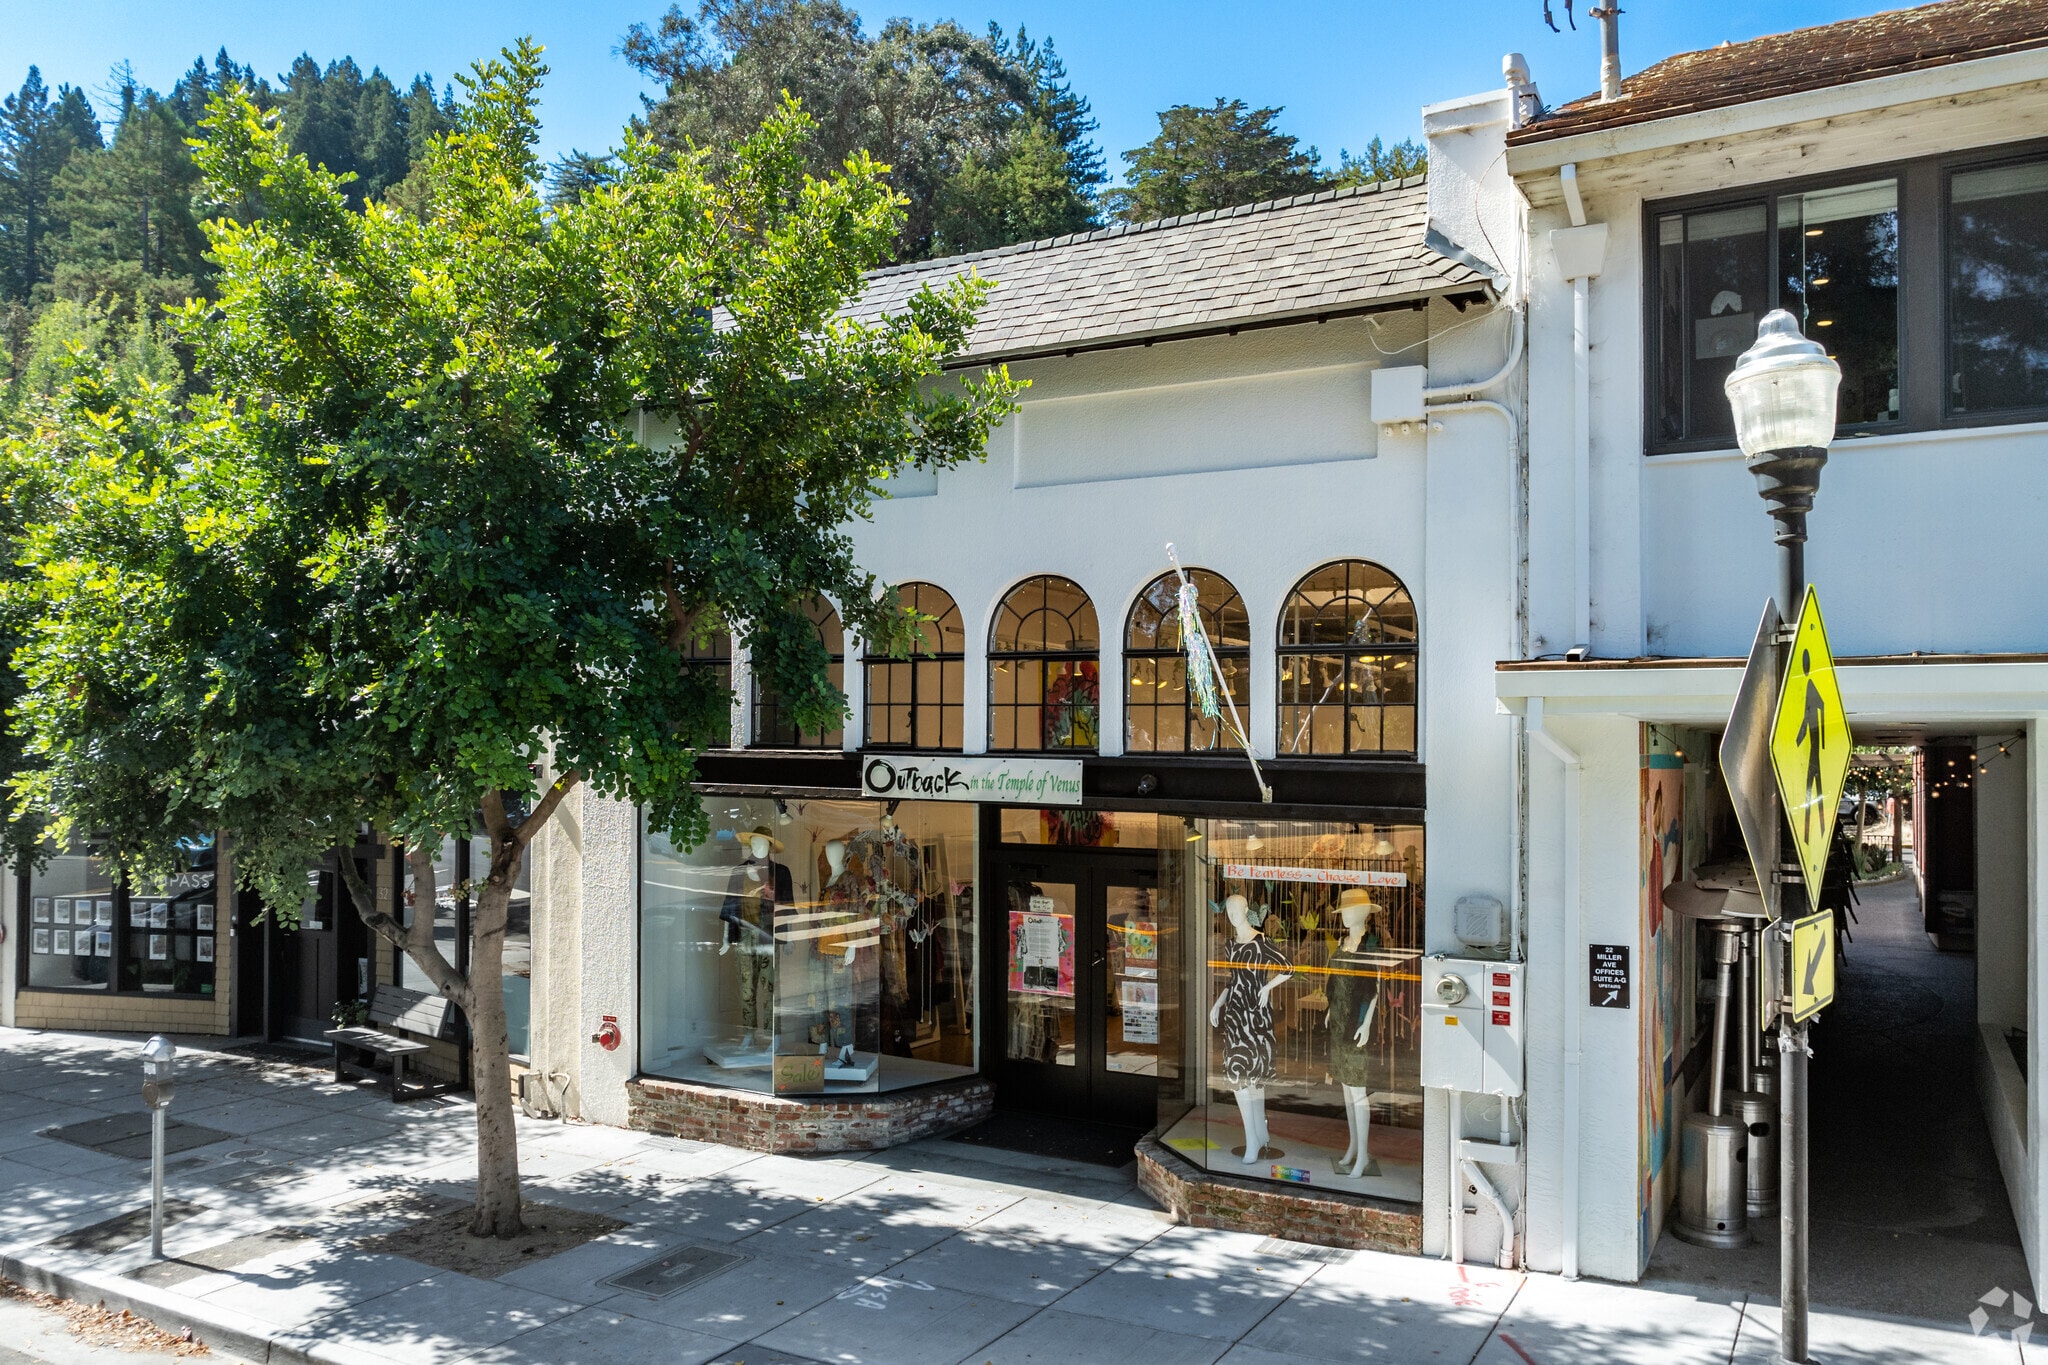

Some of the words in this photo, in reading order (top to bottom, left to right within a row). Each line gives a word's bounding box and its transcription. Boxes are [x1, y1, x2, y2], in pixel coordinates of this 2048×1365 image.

[970, 775, 979, 789] in
[981, 772, 994, 789] the
[998, 769, 1033, 798] Temple
[1036, 770, 1050, 799] of
[1050, 775, 1080, 793] Venus
[1227, 865, 1245, 877] Be
[1250, 866, 1303, 880] Fearless
[1317, 871, 1361, 884] Choose
[1367, 873, 1400, 885] Love
[1595, 968, 1624, 976] OFFICES
[780, 1063, 821, 1083] Sale
